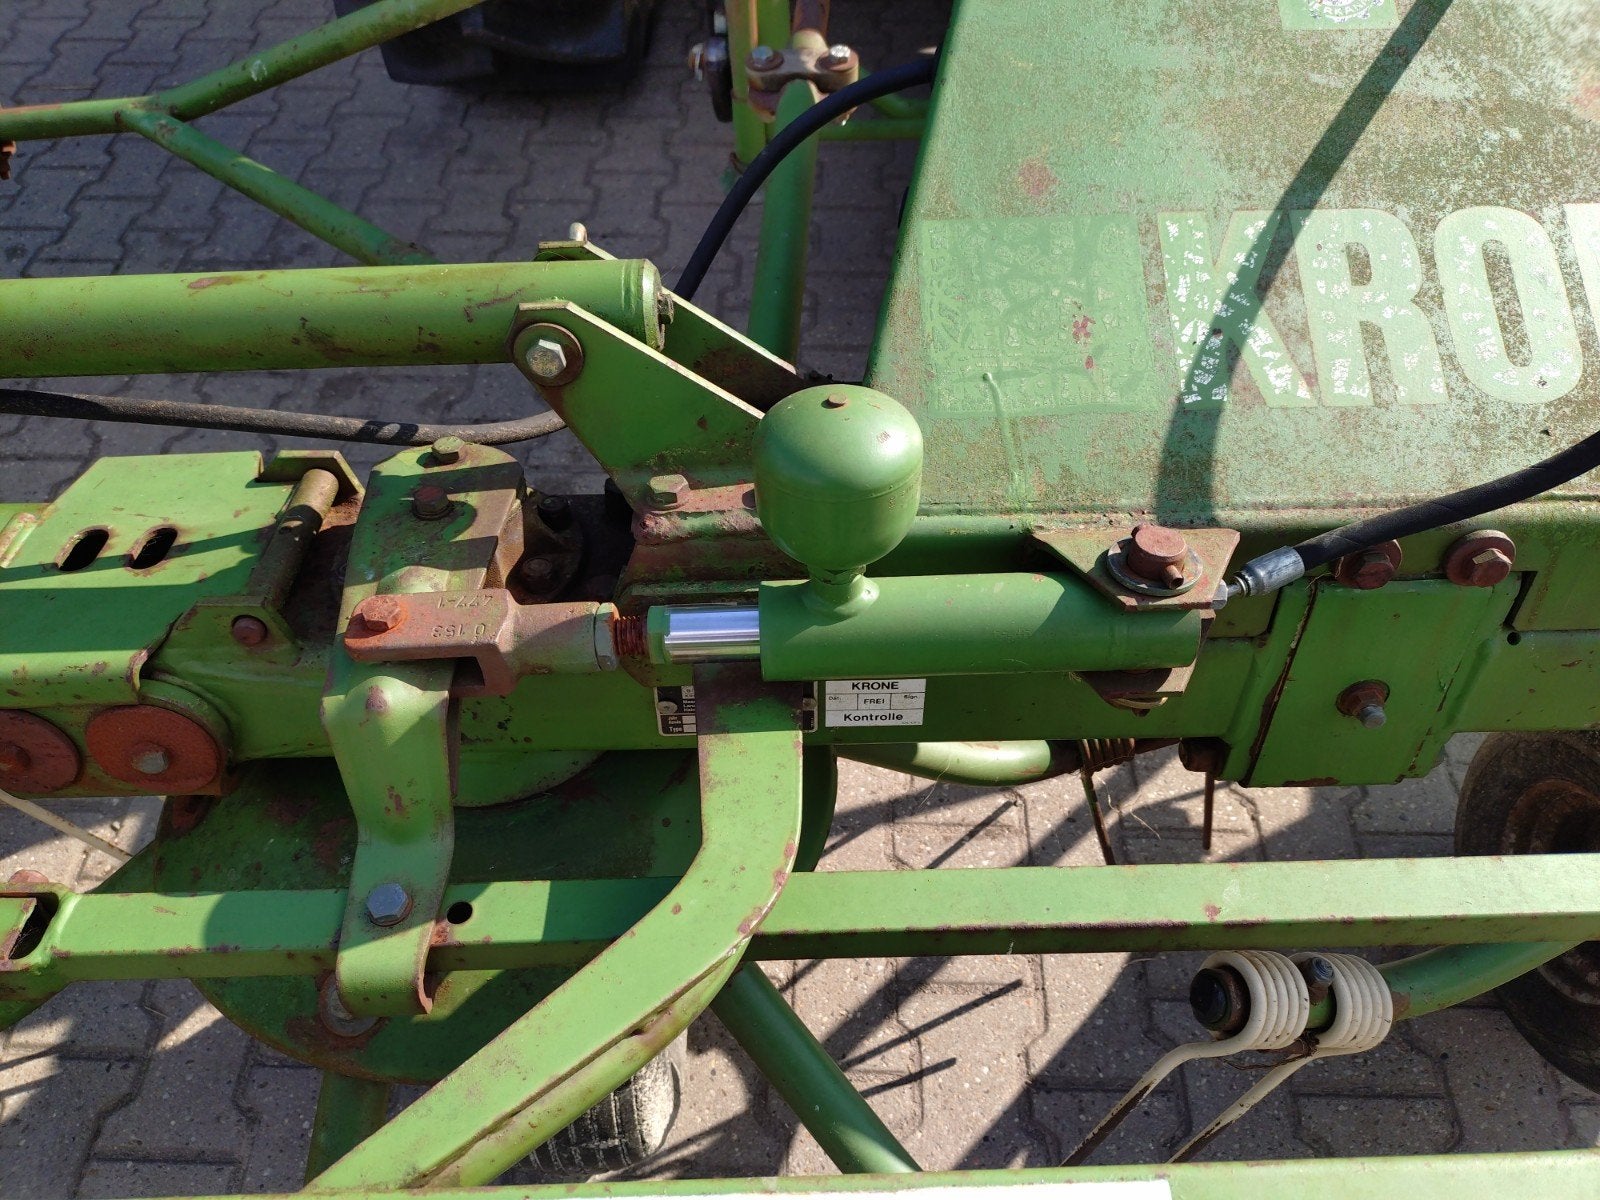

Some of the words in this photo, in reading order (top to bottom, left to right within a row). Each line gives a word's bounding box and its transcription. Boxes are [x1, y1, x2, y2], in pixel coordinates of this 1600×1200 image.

[1158, 203, 1600, 408] KRO
[851, 681, 899, 690] KRONE
[843, 712, 903, 722] Kontrolle
